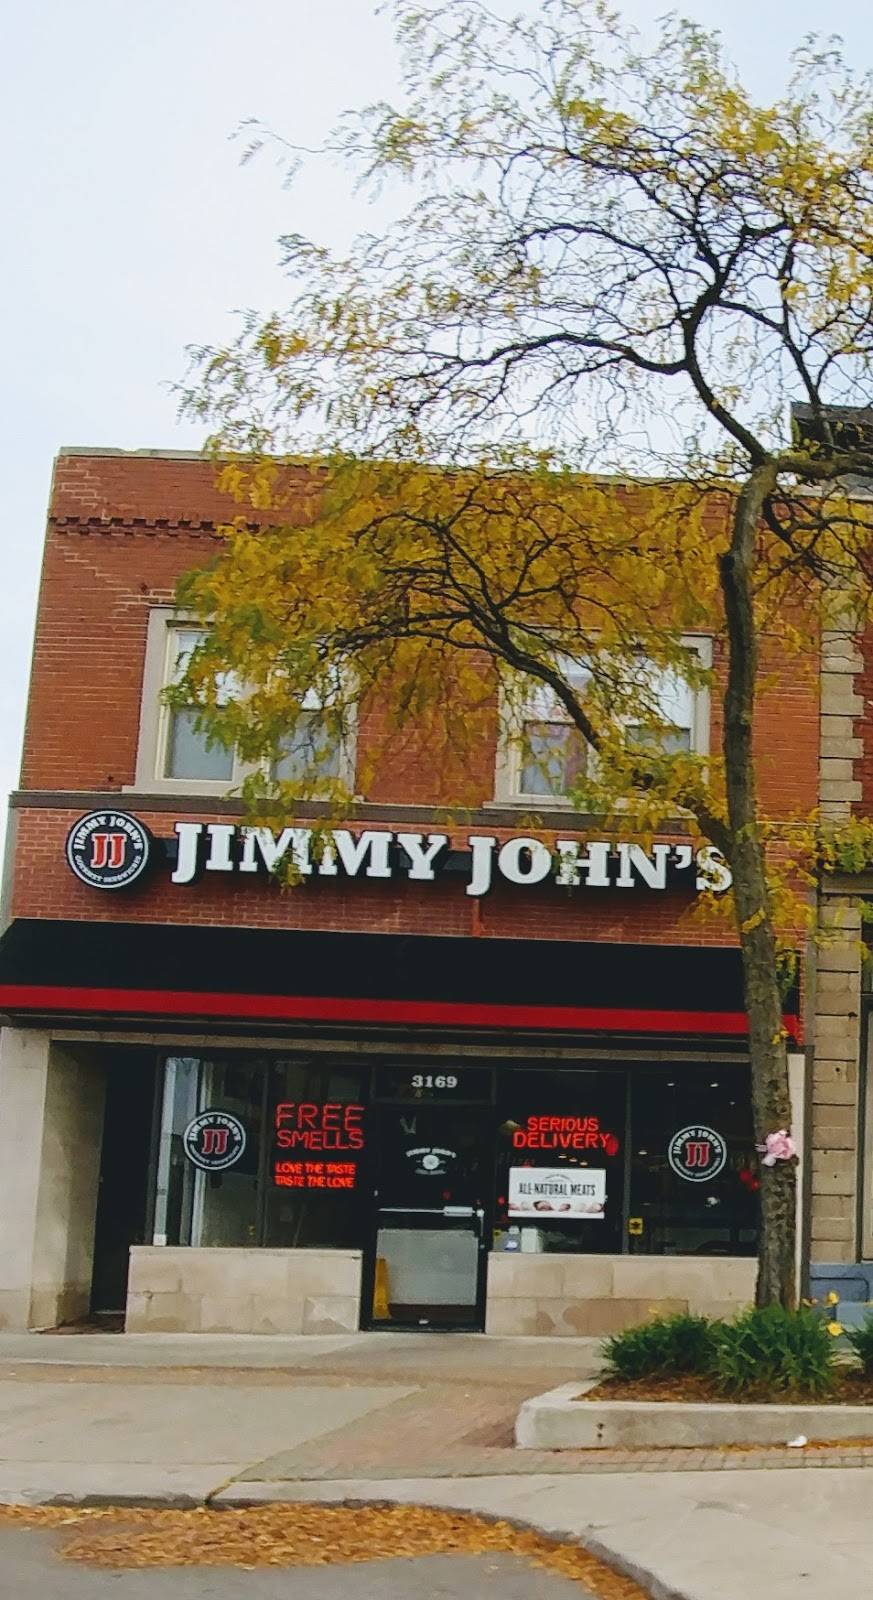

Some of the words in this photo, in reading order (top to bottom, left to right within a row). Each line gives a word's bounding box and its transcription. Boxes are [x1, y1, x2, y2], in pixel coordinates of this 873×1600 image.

[73, 815, 107, 850] JIMMY
[90, 833, 127, 869] JJ
[170, 821, 449, 884] JIMMY
[465, 835, 733, 896] JOHN'S
[410, 1074, 458, 1089] 3169
[275, 1102, 365, 1132] FREE
[526, 1115, 600, 1132] SERIOUS
[201, 1128, 230, 1155] JJ
[276, 1129, 365, 1151] SMELLS
[512, 1131, 610, 1149] DELIVERY
[685, 1141, 711, 1168] JJ
[275, 1161, 303, 1175] LOVE
[305, 1162, 324, 1175] THE
[325, 1163, 356, 1176] TASTE
[275, 1174, 305, 1188] TASTE
[306, 1175, 326, 1188] THE
[326, 1177, 355, 1189] LOVE
[518, 1182, 568, 1196] ALL-NATURAL
[569, 1183, 596, 1197] MEATS
